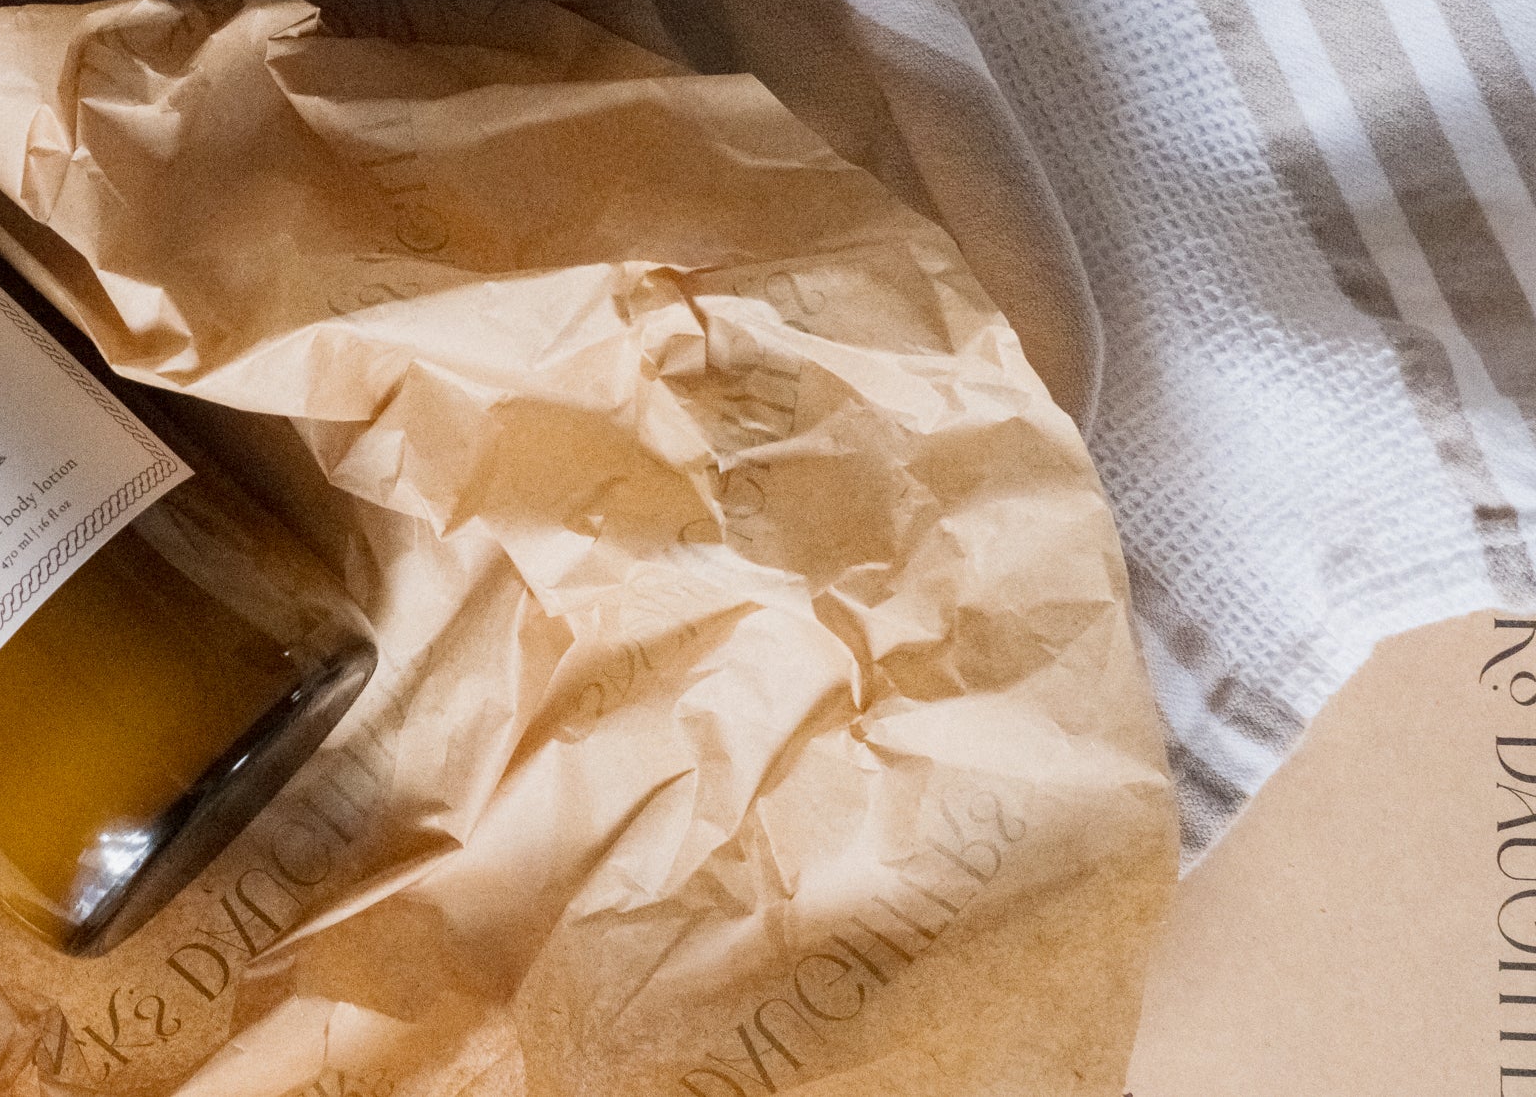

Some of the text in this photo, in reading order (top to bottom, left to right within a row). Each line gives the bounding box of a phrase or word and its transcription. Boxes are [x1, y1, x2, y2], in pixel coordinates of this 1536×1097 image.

[32, 459, 78, 494] lotion
[1, 549, 19, 570] 470
[18, 532, 34, 550] ml
[37, 518, 50, 532] 16
[58, 500, 72, 513] oz
